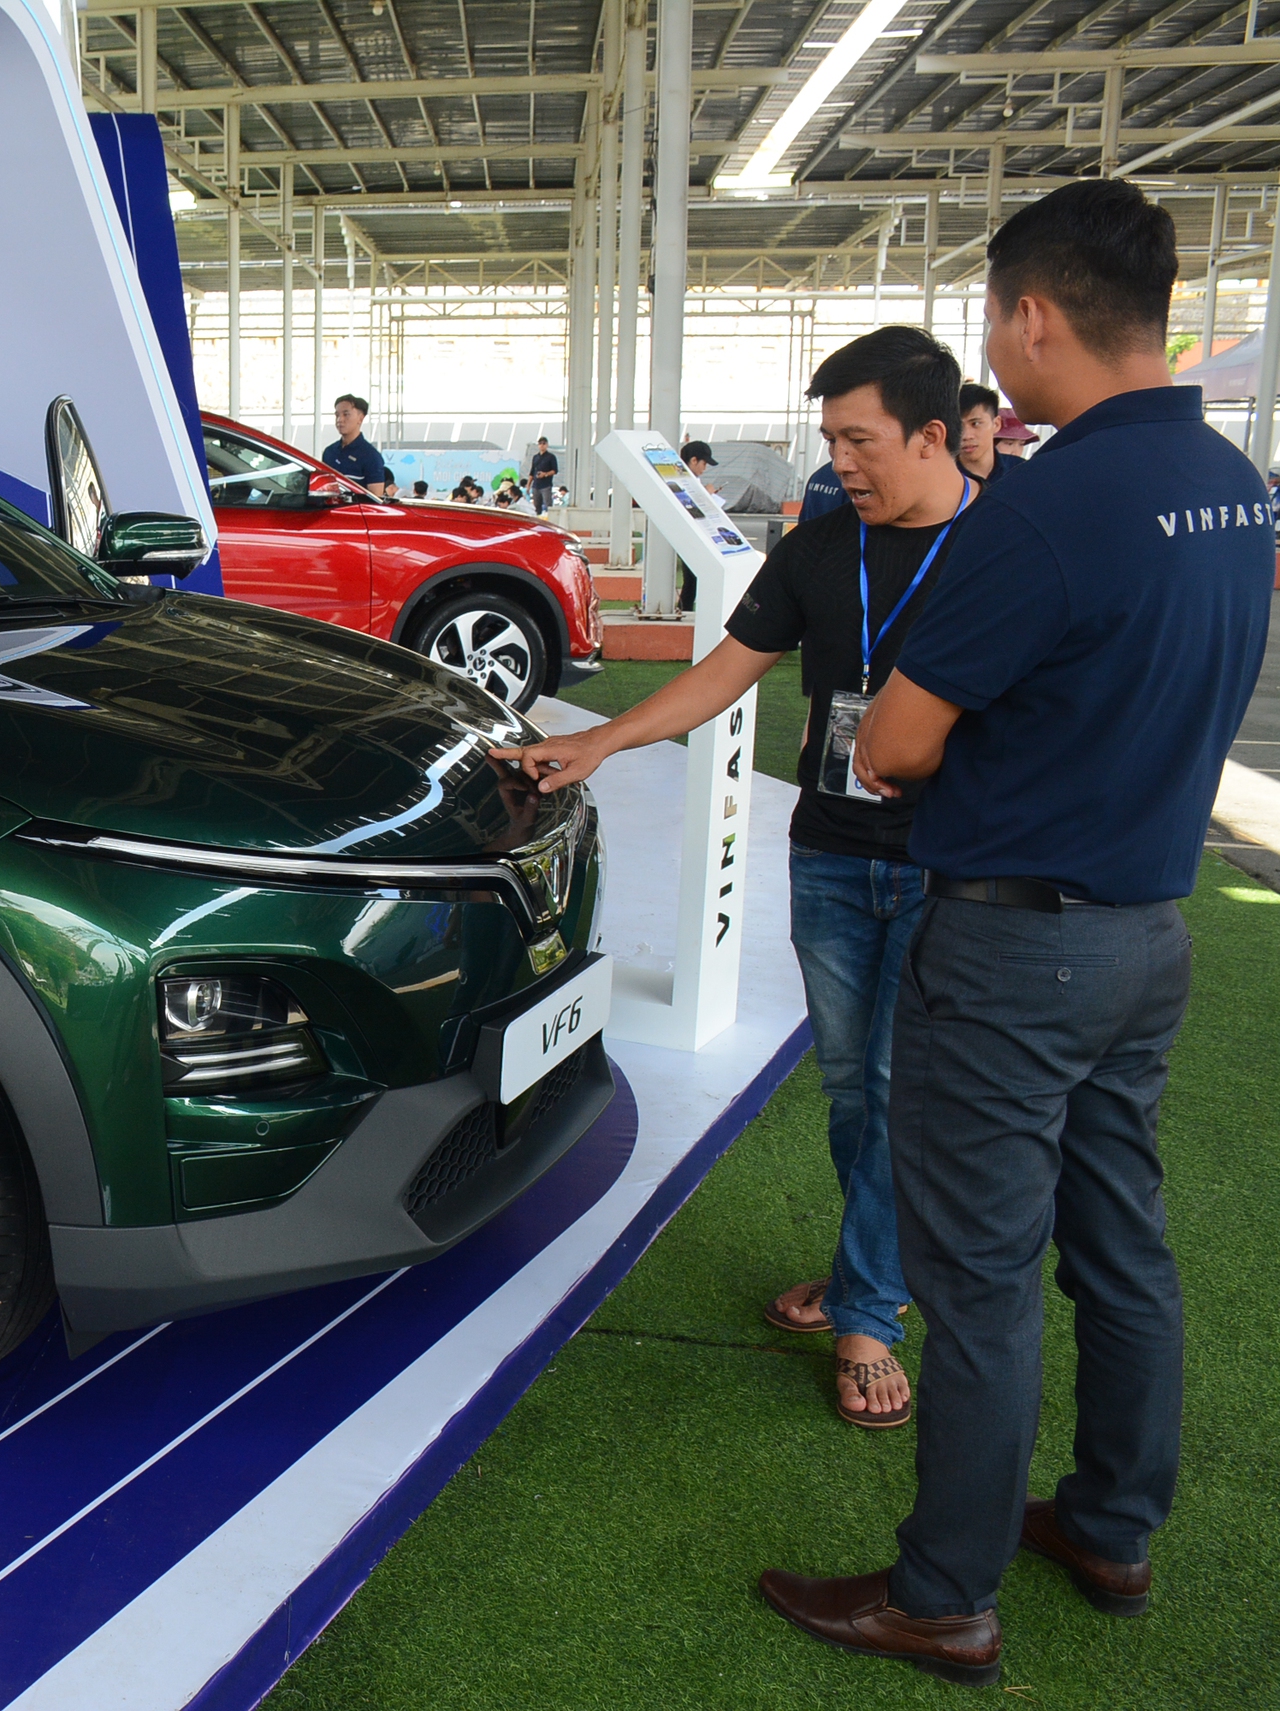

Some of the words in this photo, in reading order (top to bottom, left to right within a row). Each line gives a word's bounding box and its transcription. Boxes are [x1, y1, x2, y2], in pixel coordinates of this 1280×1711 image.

[1157, 502, 1273, 537] VINFAST
[715, 706, 743, 948] VINFAS
[542, 995, 584, 1055] VF6
